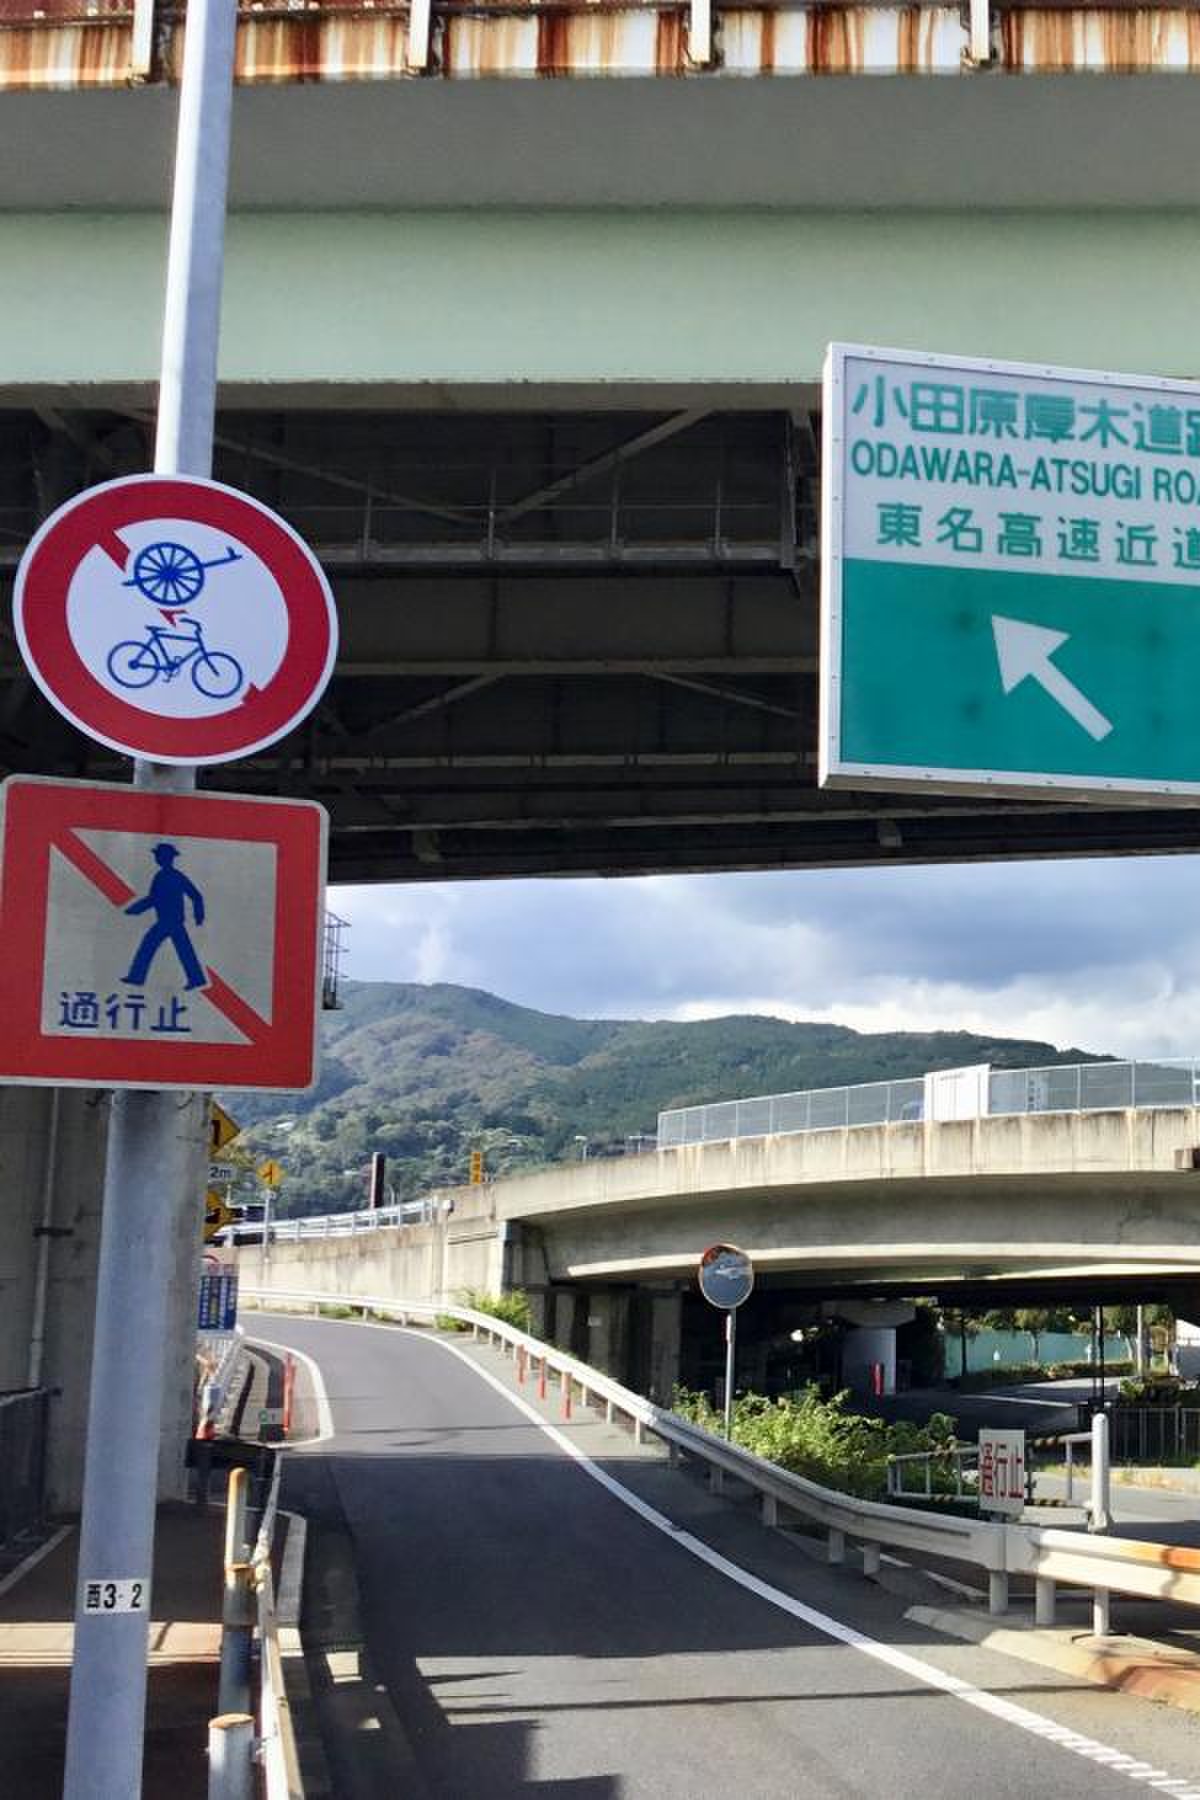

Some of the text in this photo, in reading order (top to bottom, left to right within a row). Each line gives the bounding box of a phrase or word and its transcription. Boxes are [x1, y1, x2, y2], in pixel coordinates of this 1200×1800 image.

[851, 439, 1141, 500] ODAWARA-ATSUGI
[60, 991, 192, 1032] 通行止
